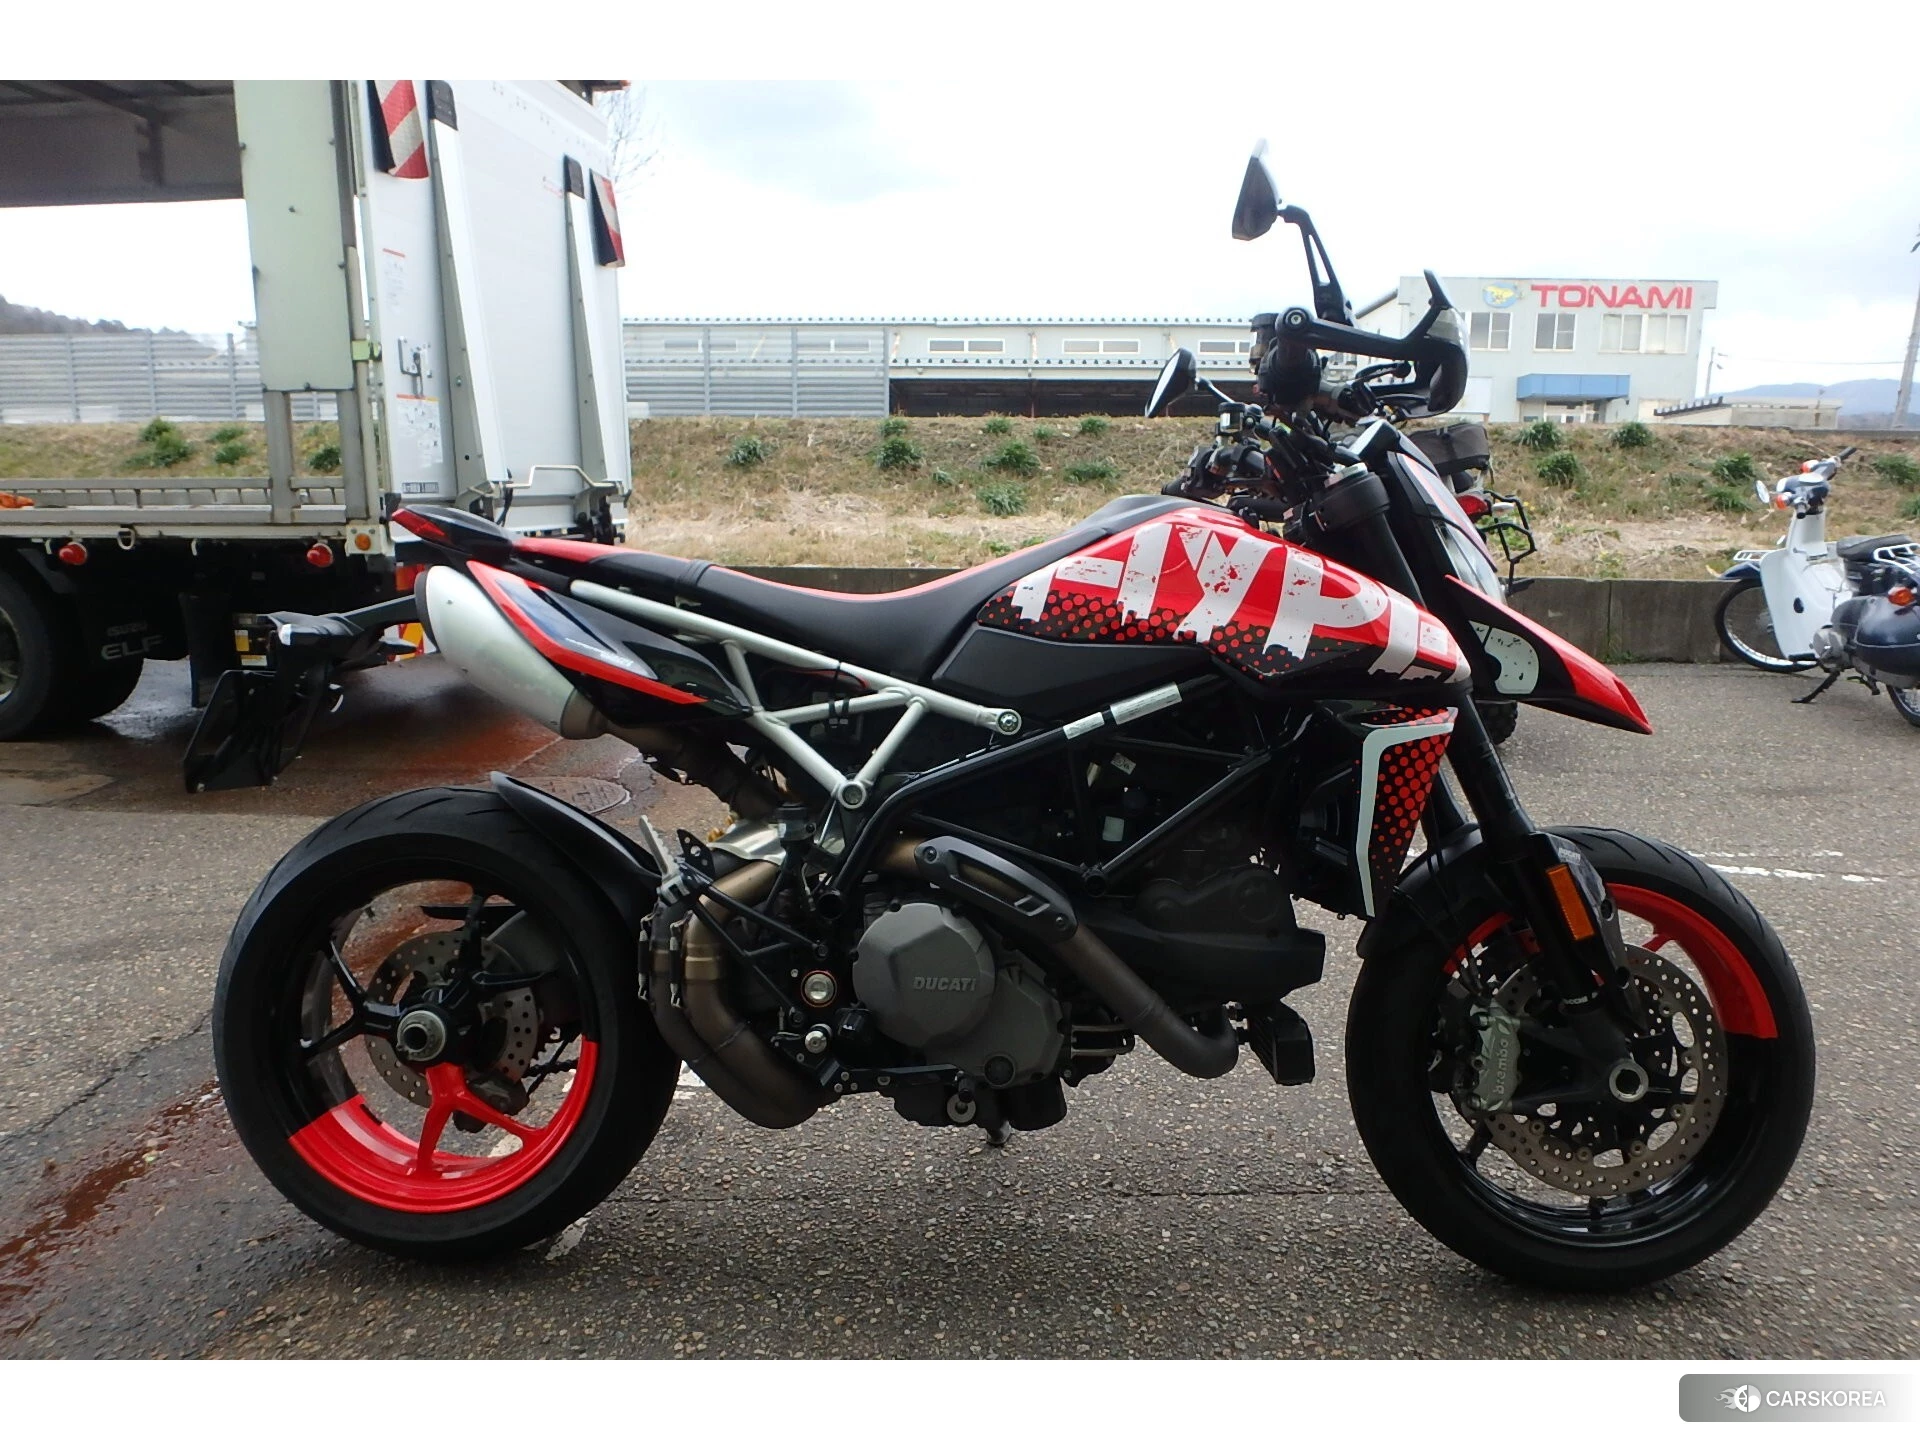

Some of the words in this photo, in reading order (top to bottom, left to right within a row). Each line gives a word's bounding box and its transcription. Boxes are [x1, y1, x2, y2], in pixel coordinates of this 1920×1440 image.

[1531, 284, 1693, 309] TONAMI
[101, 635, 166, 659] ELF
[912, 976, 977, 991] DUCATI
[1493, 1039, 1508, 1094] brembo
